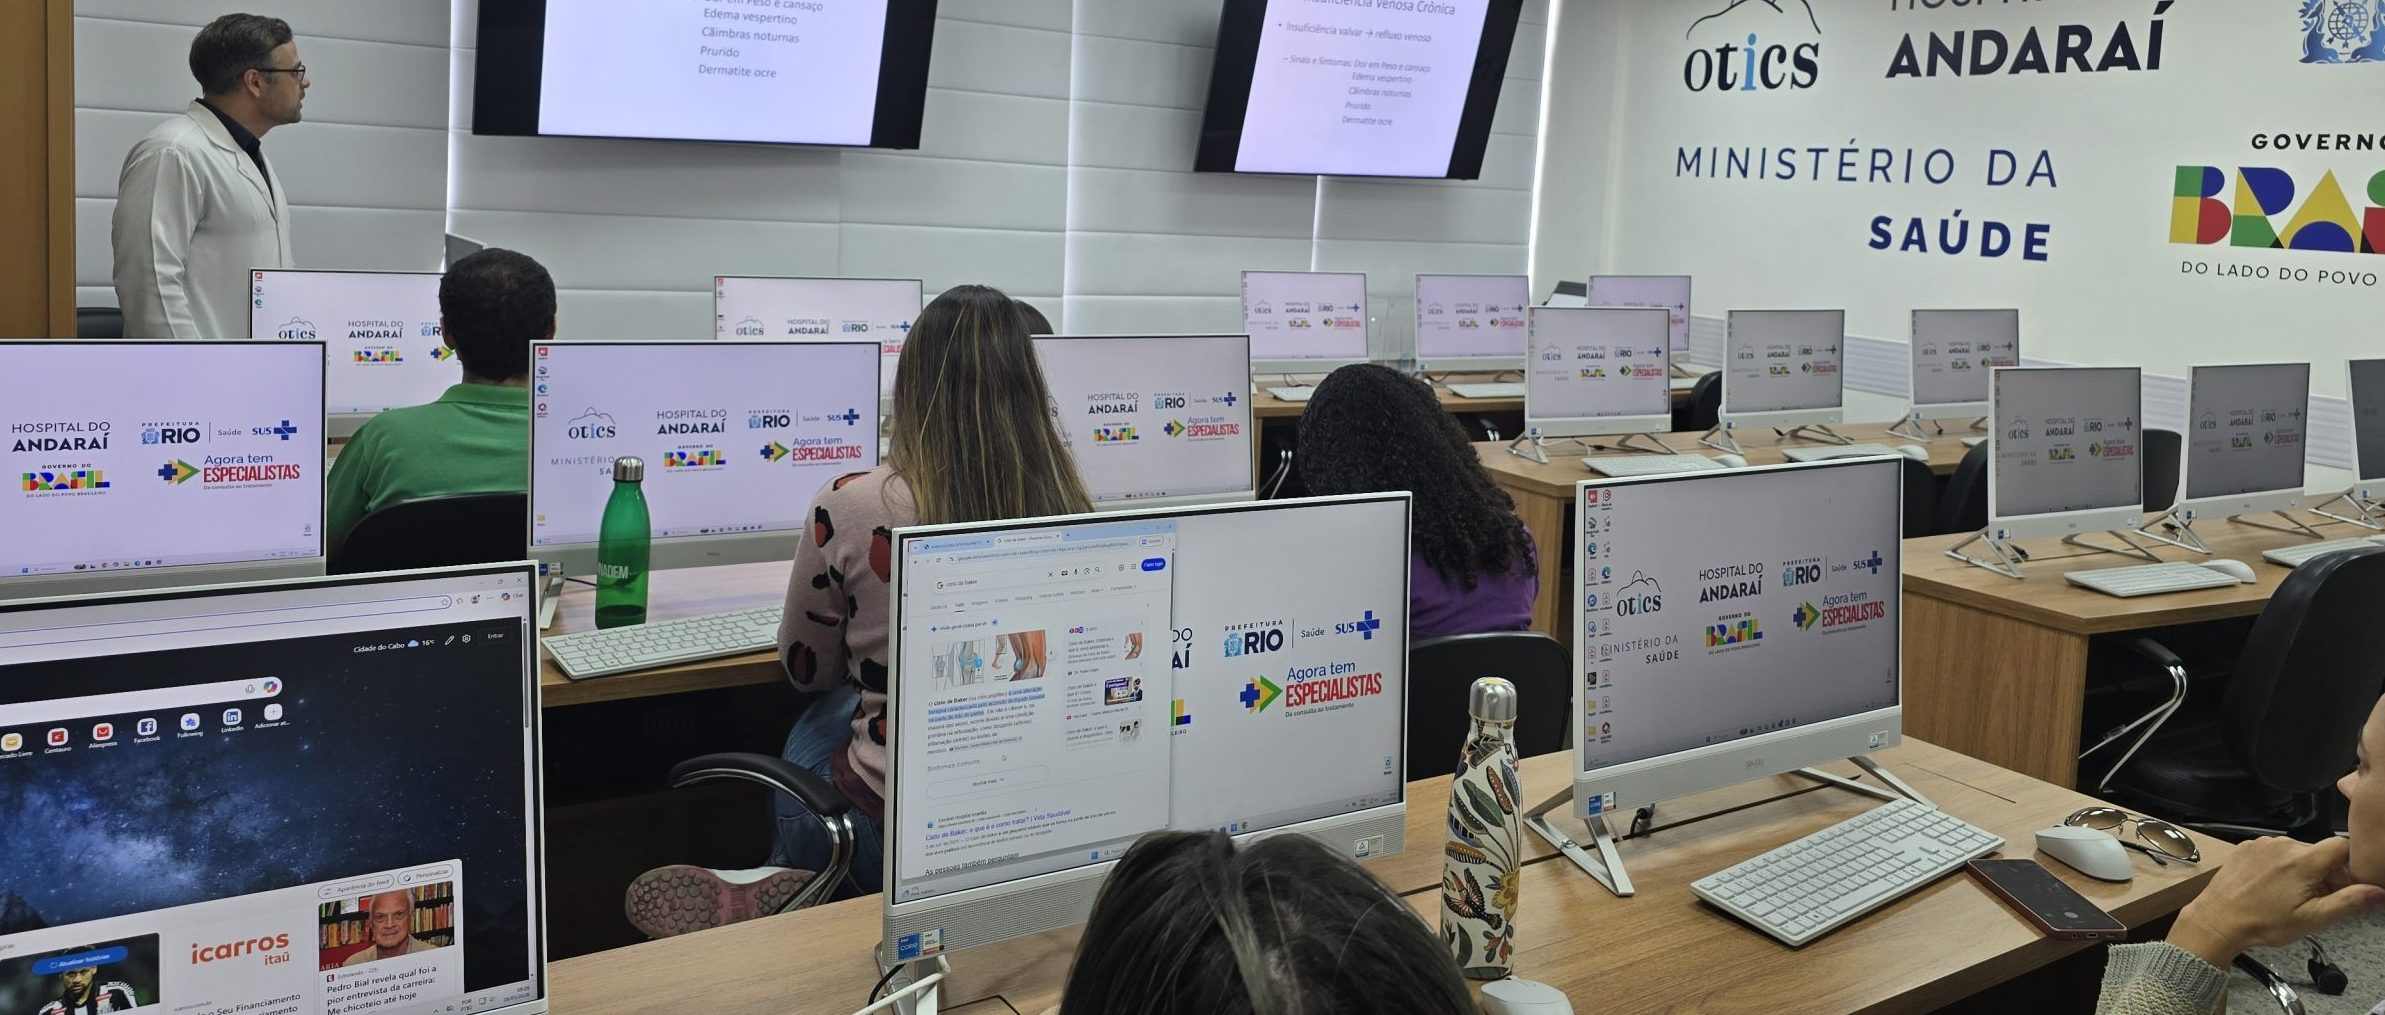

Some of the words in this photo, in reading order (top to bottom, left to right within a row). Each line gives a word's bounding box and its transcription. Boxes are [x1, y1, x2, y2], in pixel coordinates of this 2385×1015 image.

[783, 2, 823, 12] cansaço
[704, 8, 740, 20] Edema
[742, 12, 797, 25] vespertino
[753, 32, 799, 44] noturnas
[1375, 30, 1402, 40] refluxo
[1404, 33, 1431, 42] venoso
[1885, 0, 2174, 78] ANDARAÍ
[700, 46, 740, 57] Prurido
[1354, 59, 1367, 68] Dor
[1683, 33, 1820, 92] otics
[698, 64, 752, 77] Dermatite
[754, 69, 777, 78] ocre
[1352, 72, 1375, 81] Edema
[1377, 75, 1412, 84] vespertino
[1346, 101, 1371, 110] Prurido
[1676, 138, 1955, 184] MINISTÉRIO
[1986, 149, 2058, 188] DA
[1868, 209, 2051, 261] SAÚDE
[2181, 261, 2208, 274] DO
[2217, 263, 2269, 279] LADO
[2279, 267, 2308, 281] DO
[2318, 270, 2377, 286] POVO
[278, 328, 316, 340] otics
[349, 327, 403, 339] ANDARAÍ
[736, 325, 764, 336] otics
[851, 323, 868, 333] RIO
[1087, 393, 1125, 401] HOSPITAL
[1127, 392, 1139, 400] DO
[1165, 397, 1185, 410] RIO
[657, 410, 708, 420] HOSPITAL
[710, 409, 727, 418] DO
[1088, 401, 1138, 415] ANDARAÍ
[12, 422, 84, 433] HOSPITAL
[88, 421, 110, 432] DO
[657, 418, 726, 435] ANDARAÍ
[762, 414, 790, 428] RIO
[1187, 416, 1212, 425] Agora
[2089, 421, 2102, 432] RIO
[161, 427, 200, 444] RIO
[218, 428, 242, 436] Saúde
[252, 427, 272, 436] SUS
[568, 423, 616, 439] otics
[1187, 423, 1239, 437] ESPECIALISTAS
[2045, 424, 2075, 437] ANDARAÍ
[12, 432, 110, 452] ANDARAÍ
[793, 437, 822, 447] Agora
[824, 436, 843, 445] tem
[204, 454, 244, 467] Agora
[248, 453, 273, 463] tem
[792, 445, 862, 461] ESPECIALISTAS
[551, 455, 615, 466] MINISTÉRIO
[203, 463, 300, 483] ESPECIALISTAS
[1782, 556, 1820, 567] PREFEITURA
[1831, 563, 1848, 573] Saúde
[1852, 560, 1867, 570] SUS
[1699, 565, 1747, 582] HOSPITAL
[1749, 562, 1764, 575] DO
[1795, 564, 1821, 585] RIO
[1699, 574, 1763, 603] ANDARAÍ
[1616, 592, 1662, 617] otics
[1822, 593, 1849, 609] Agora
[1850, 591, 1867, 603] tem
[1822, 600, 1885, 628] ESPECIALISTAS
[1224, 619, 1283, 632] PREFEITURA
[1301, 627, 1325, 638] Saúde
[1335, 622, 1355, 635] SUS
[353, 645, 377, 653] Cidade
[387, 642, 405, 650] Cabo
[487, 632, 504, 640] Entrar
[1244, 628, 1284, 655] RIO
[1665, 634, 1679, 646] DA
[1645, 650, 1679, 664] SAÚDE
[1286, 667, 1326, 683] Agora
[1330, 661, 1356, 674] tem
[1285, 672, 1382, 708] ESPECIALISTAS
[177, 731, 204, 739] Following
[221, 725, 244, 733] LinkedIn
[133, 736, 161, 745] Facebook
[44, 746, 72, 754] Centauro
[974, 825, 985, 834] que
[996, 821, 1011, 829] como
[1033, 813, 1046, 822] Vida
[1046, 808, 1071, 819] Saudável
[415, 868, 449, 879] Personalizar
[925, 868, 934, 876] As
[934, 863, 960, 876] pessoas
[961, 857, 986, 869] também
[337, 883, 367, 893] Aparência
[376, 879, 390, 887] feed
[191, 933, 290, 965] icarros
[326, 982, 352, 994] Pedro
[354, 978, 370, 989] Bial
[371, 974, 396, 985] revela
[399, 969, 417, 982] qual
[418, 966, 430, 975] foi
[327, 995, 345, 1006] pior
[346, 987, 388, 1001] entrevista
[389, 984, 401, 992] da
[402, 977, 435, 990] carreira:
[217, 1007, 234, 1015] Seu
[235, 993, 301, 1013] Financiamento
[327, 1007, 342, 1015] Me
[343, 999, 382, 1013] chicoteio
[383, 996, 397, 1005] até
[399, 991, 417, 1003] hoje
